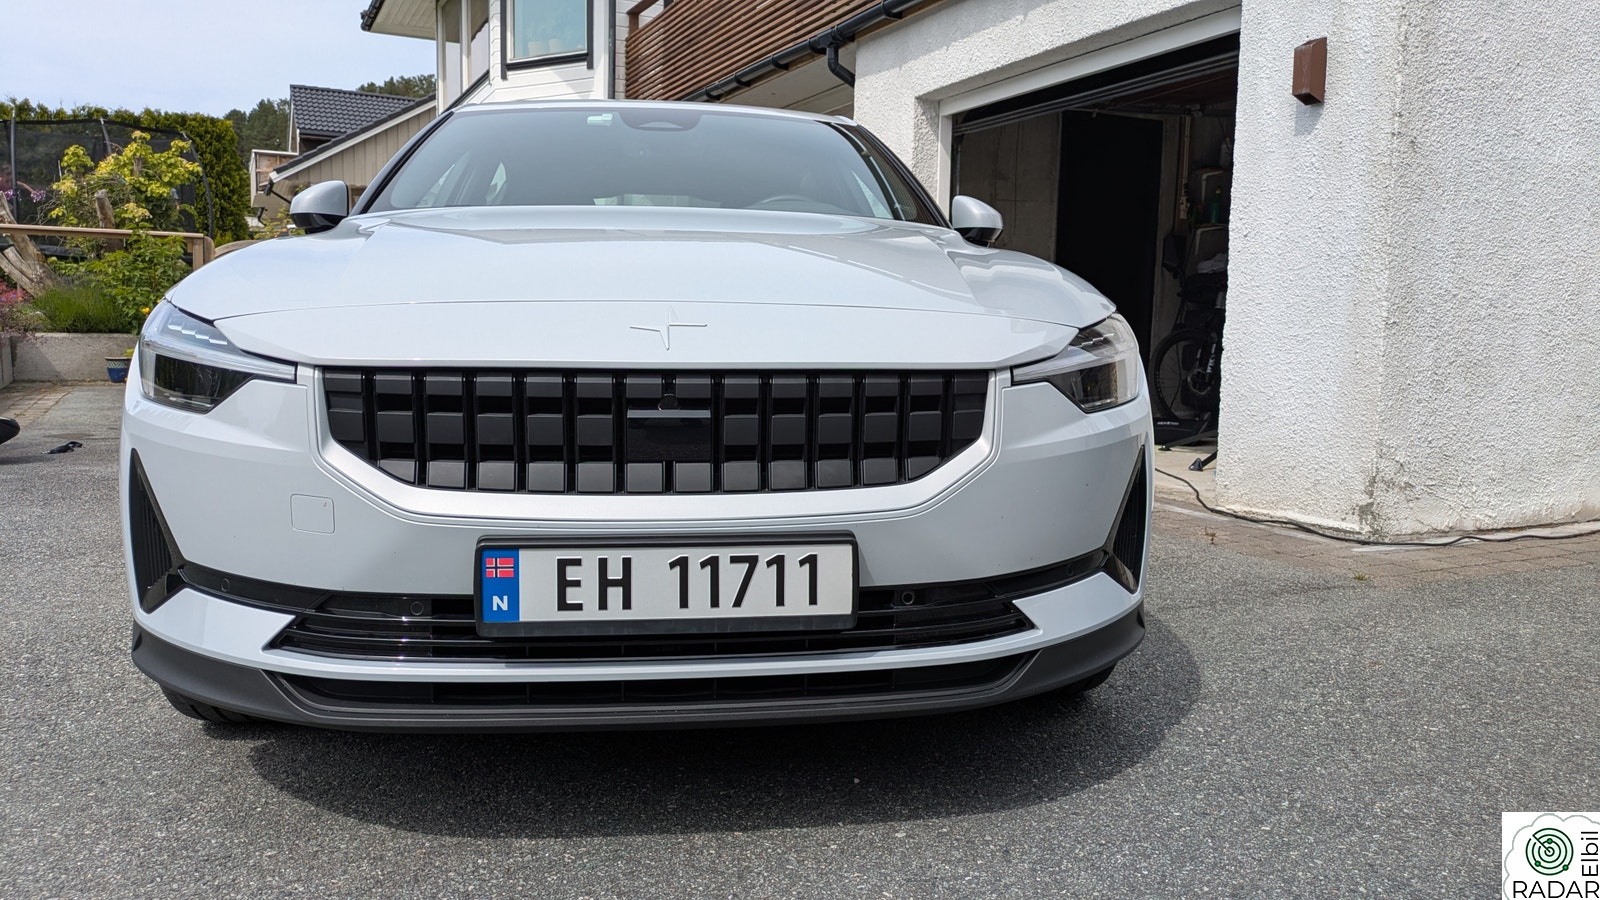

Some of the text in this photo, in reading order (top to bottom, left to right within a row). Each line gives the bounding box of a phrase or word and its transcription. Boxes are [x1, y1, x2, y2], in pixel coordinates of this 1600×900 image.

[556, 553, 818, 611] EH 11711
[492, 595, 508, 611] N
